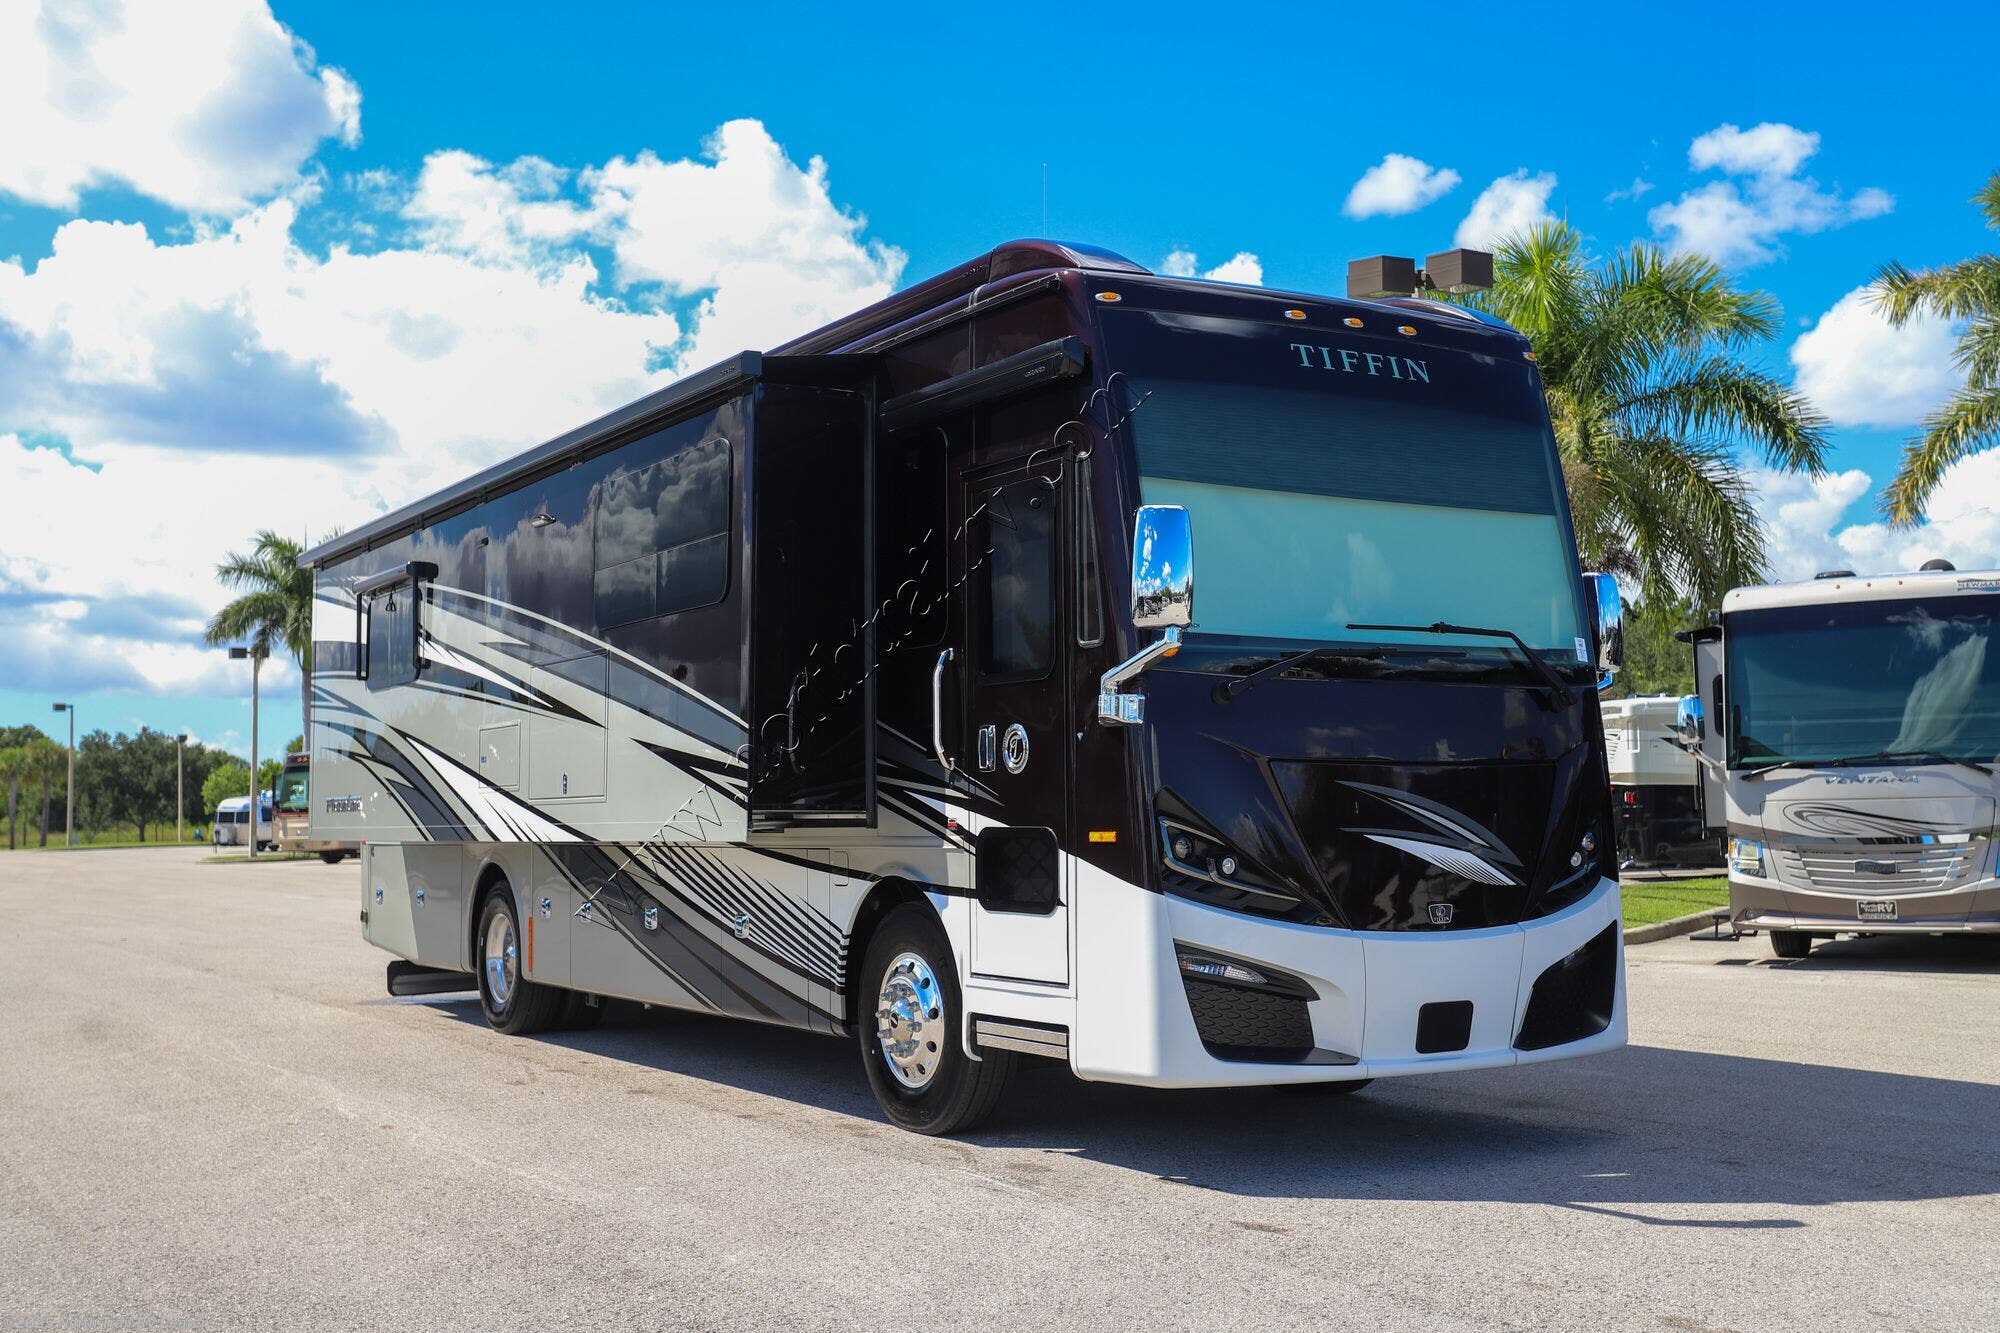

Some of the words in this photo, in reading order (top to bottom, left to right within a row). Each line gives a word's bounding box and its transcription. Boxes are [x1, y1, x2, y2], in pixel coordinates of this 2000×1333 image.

[1290, 343, 1430, 383] TIFFIN
[1824, 775, 1919, 785] VENTANA
[1877, 903, 1894, 912] RV
